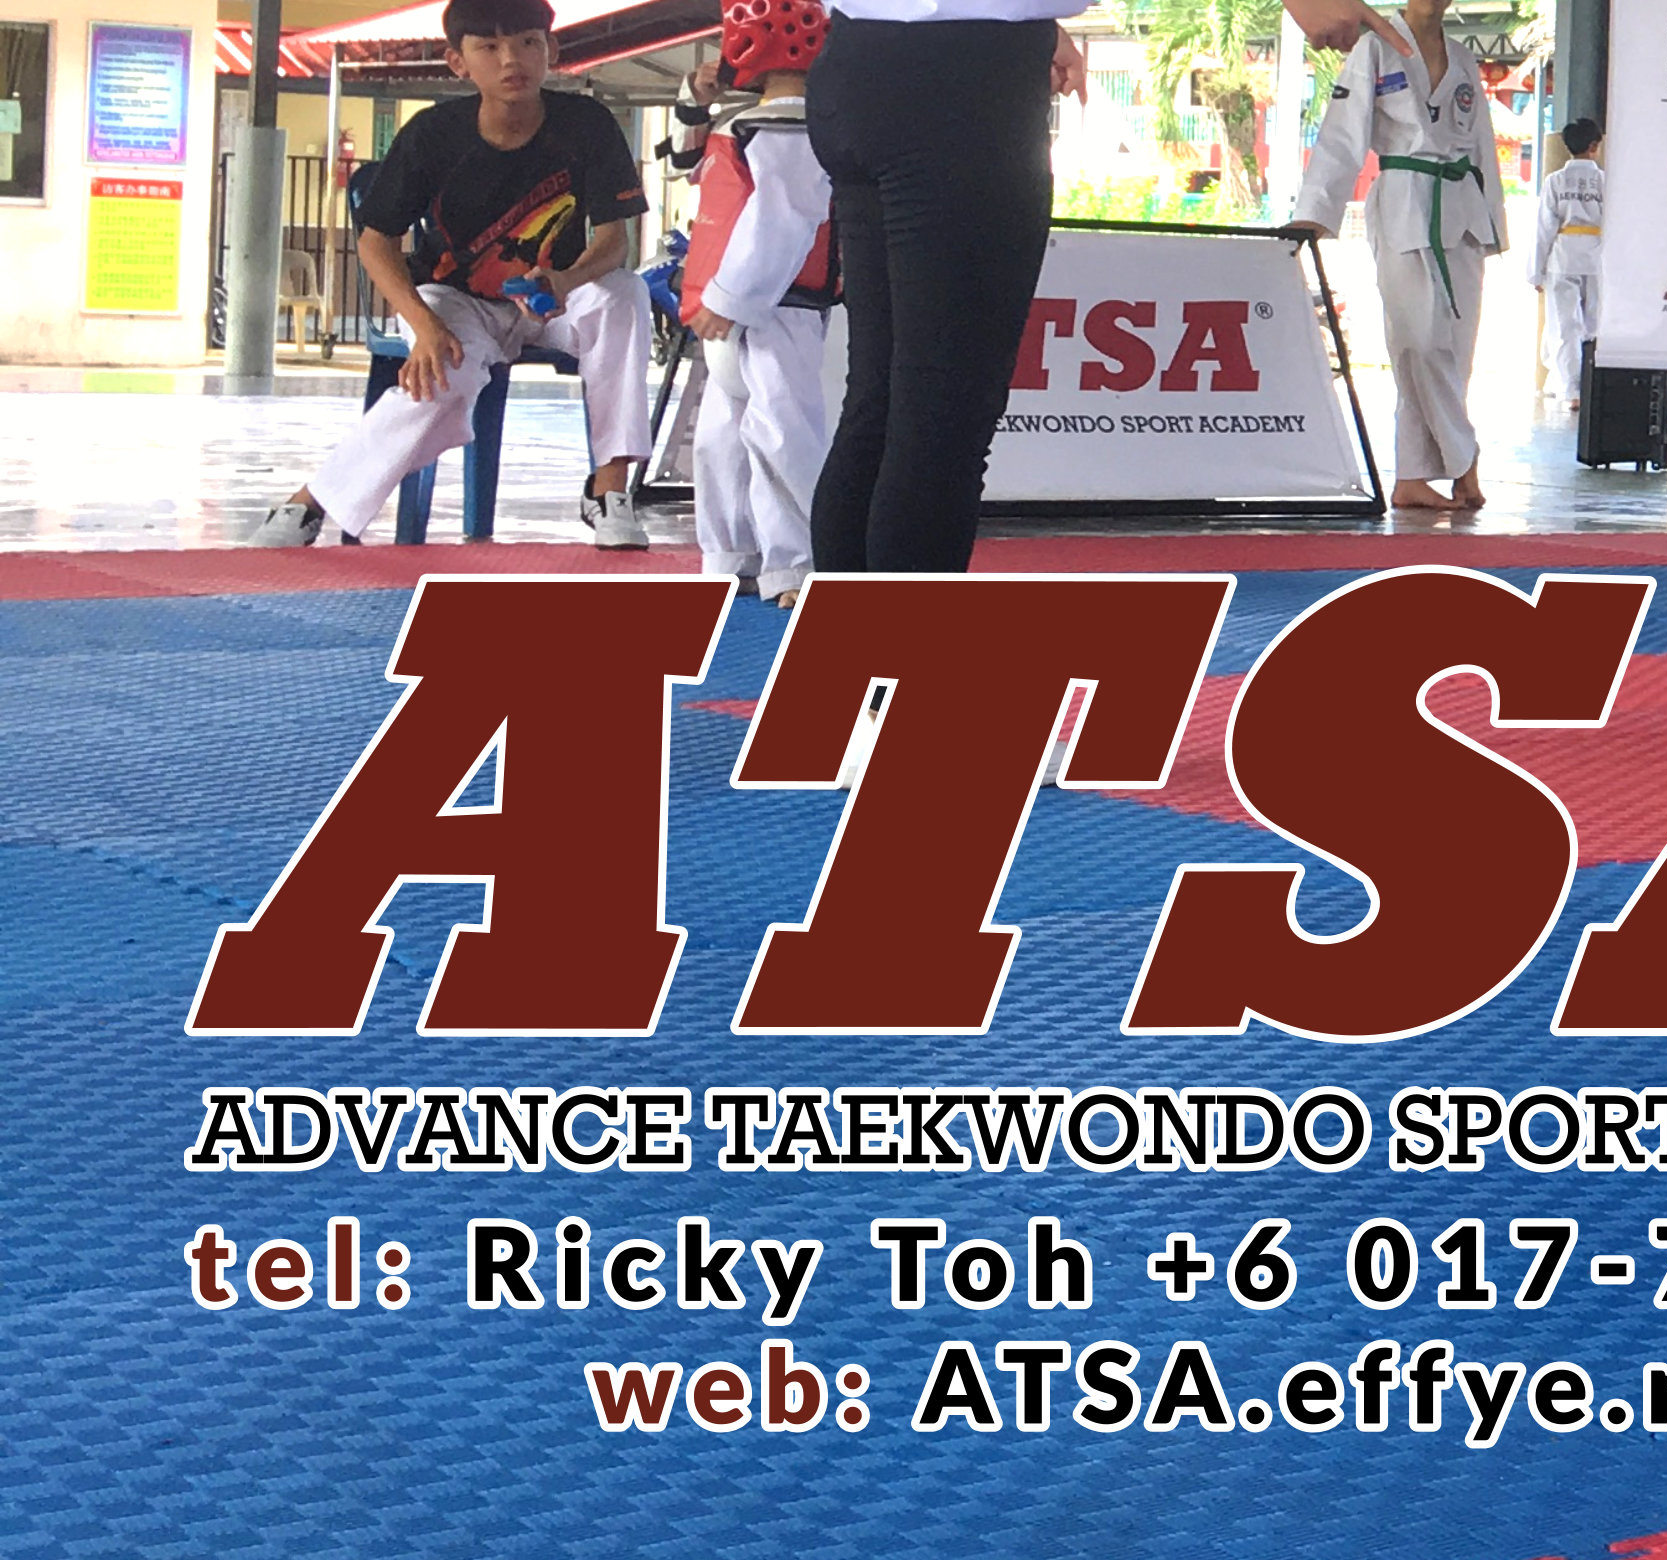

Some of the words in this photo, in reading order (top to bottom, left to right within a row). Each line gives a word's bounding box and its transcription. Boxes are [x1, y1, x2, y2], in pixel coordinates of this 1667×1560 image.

[1008, 298, 1260, 392] TSA
[995, 415, 1115, 434] EKWONDO
[1120, 415, 1193, 434] SPORT
[1199, 415, 1306, 434] ACADEMY
